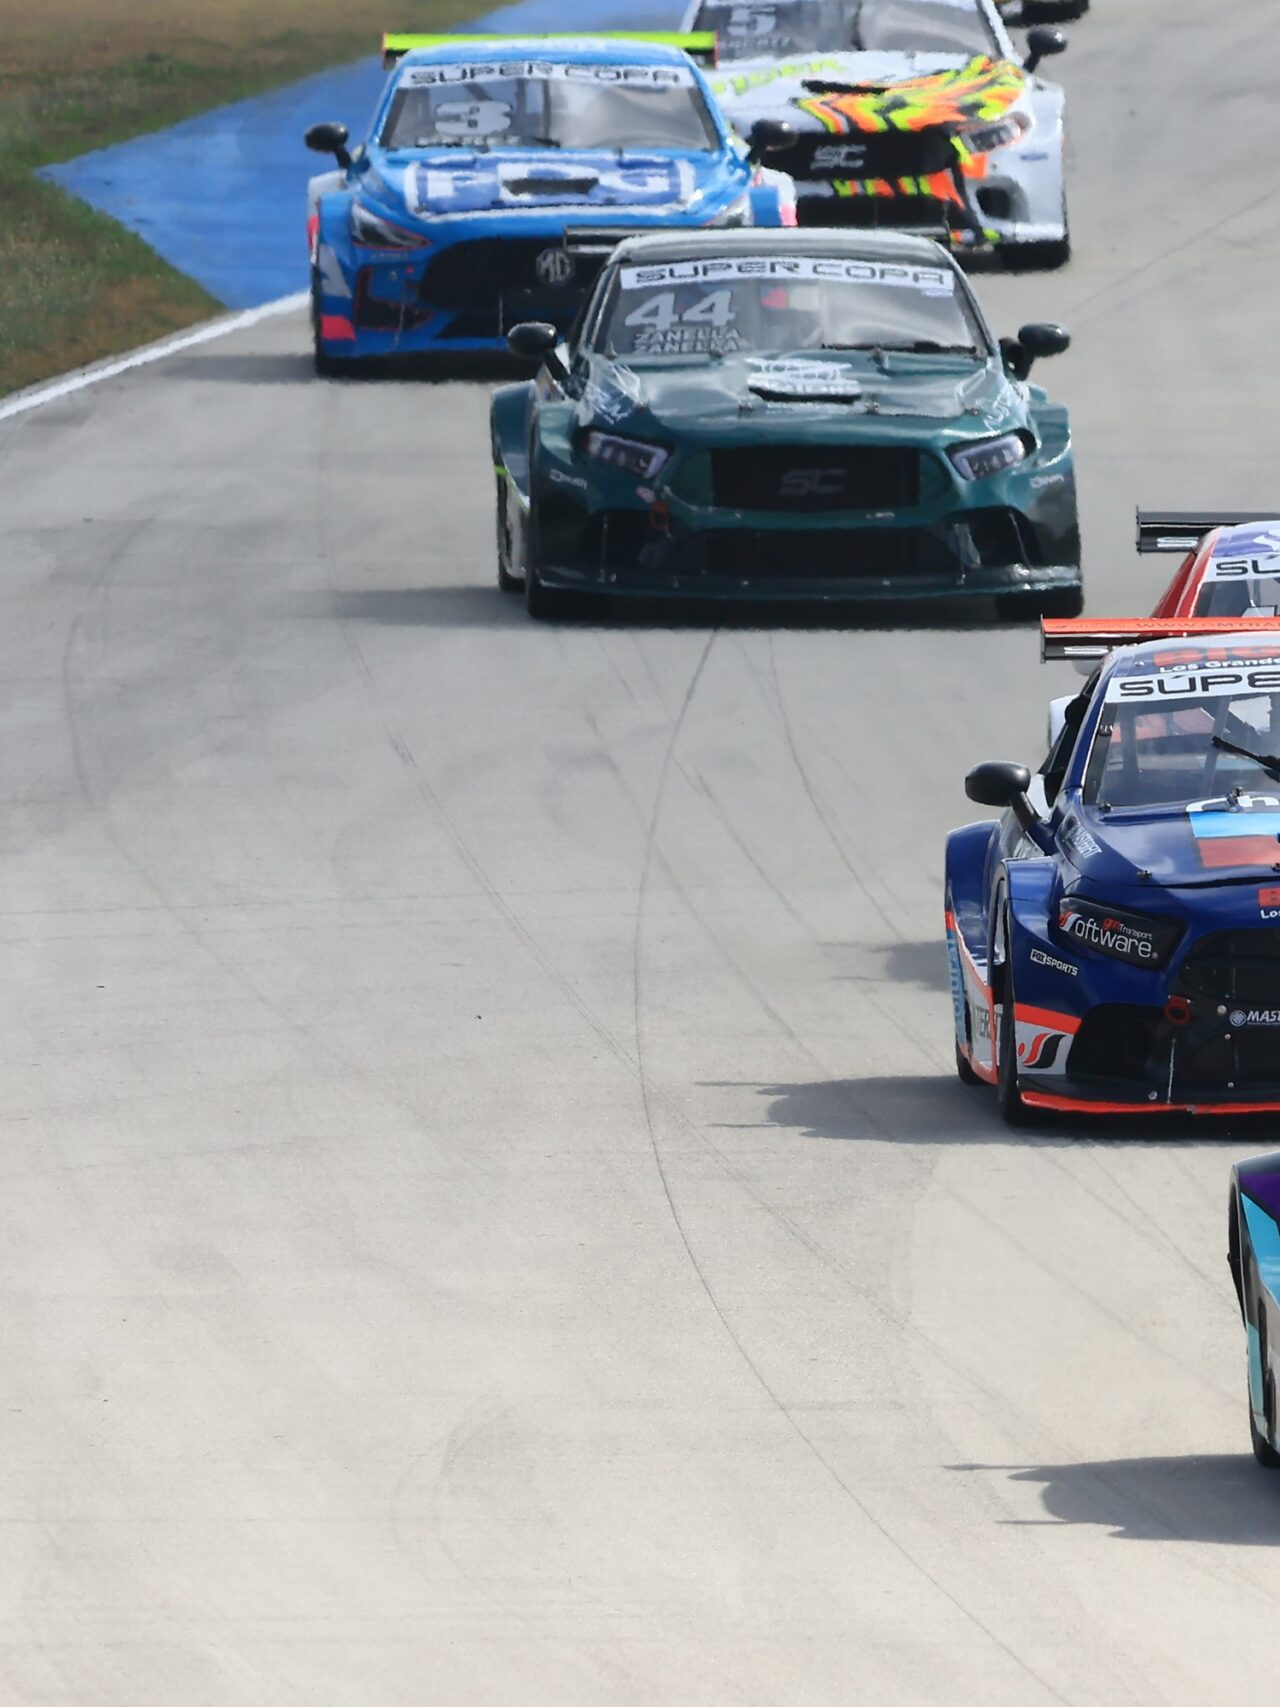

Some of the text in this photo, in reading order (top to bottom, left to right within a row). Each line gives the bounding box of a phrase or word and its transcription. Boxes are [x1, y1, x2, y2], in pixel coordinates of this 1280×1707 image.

[727, 7, 776, 35] 5
[565, 67, 680, 84] COPA
[435, 101, 512, 135] 3
[813, 263, 944, 285] COPA
[624, 290, 736, 330] 44
[1160, 662, 1199, 673] Los
[1030, 949, 1079, 977] FOX SPORTS
